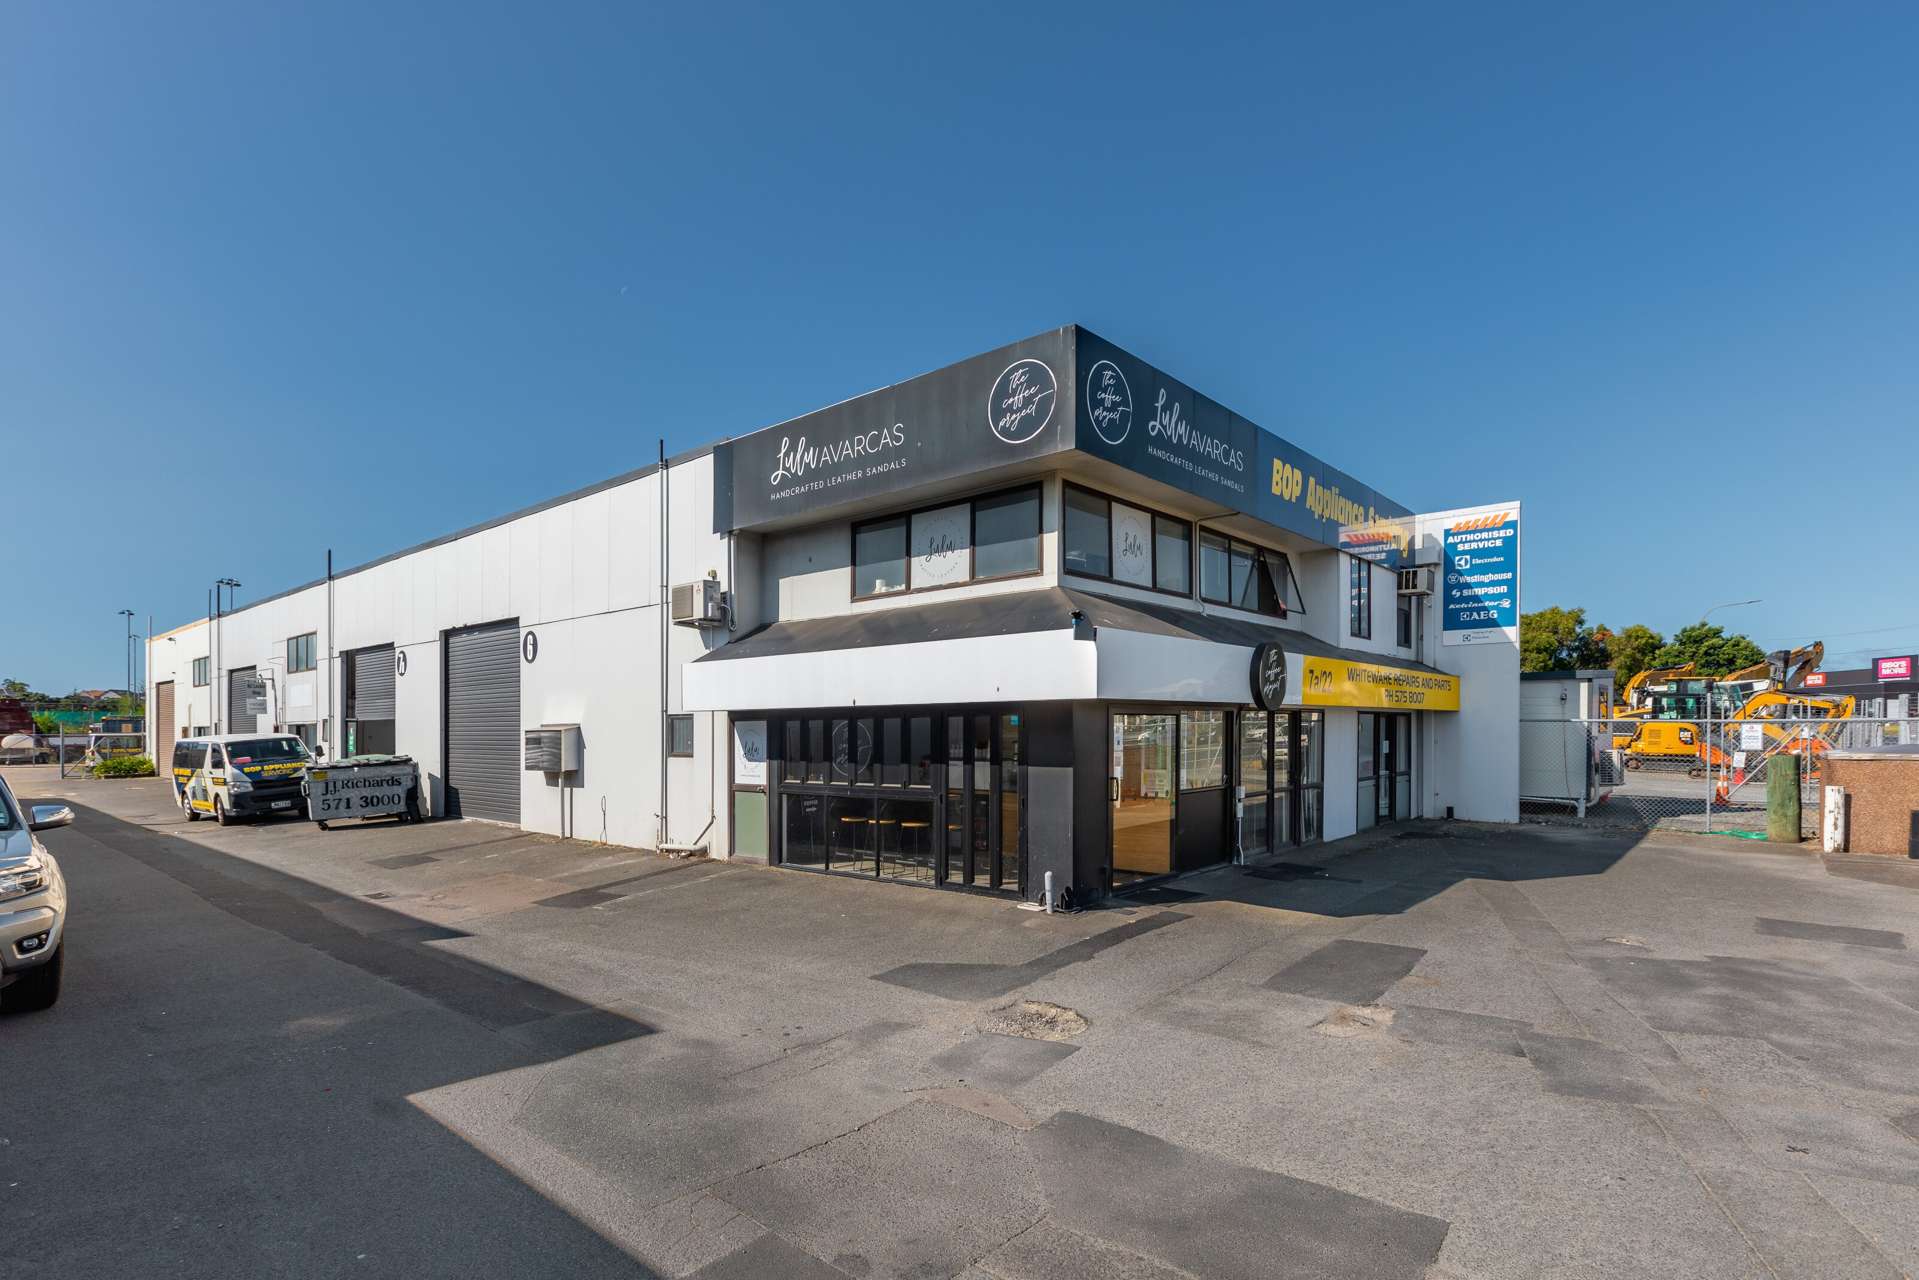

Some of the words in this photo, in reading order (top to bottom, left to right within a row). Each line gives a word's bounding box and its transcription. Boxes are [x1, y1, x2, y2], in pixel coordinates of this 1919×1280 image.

[1009, 367, 1028, 393] the
[1102, 369, 1116, 387] the
[1002, 384, 1040, 409] coffee
[1097, 387, 1122, 407] coffee
[998, 389, 1054, 431] project
[1094, 407, 1130, 427] project
[1148, 388, 1190, 444] Lulu
[1190, 430, 1243, 471] AVARCAS
[771, 436, 819, 485] Lulu
[819, 423, 905, 468] AVARCAS
[770, 481, 824, 501] HANDCRAFTED
[827, 469, 863, 487] LEATHER
[866, 458, 907, 476] SANDALS
[1147, 445, 1193, 471] HANDCRAFTED
[1194, 465, 1219, 482] LEATHER
[1220, 476, 1245, 493] SANDALS
[1271, 457, 1303, 503] BOP
[1306, 476, 1365, 529] Appliance
[925, 534, 956, 562] Lulu
[1446, 529, 1514, 543] AUTHORISED
[1457, 539, 1504, 551] SERVICE
[1460, 572, 1512, 583] Westinghouse
[1471, 610, 1498, 620] AEG
[1347, 667, 1393, 686] WHITEWARE
[1393, 673, 1420, 688] REPAIRS
[1421, 678, 1434, 689] AND
[1434, 678, 1452, 691] PARTS
[1395, 689, 1408, 703] 575
[1408, 691, 1424, 704] 8007
[321, 797, 352, 811] 571
[360, 793, 401, 808] 3000
